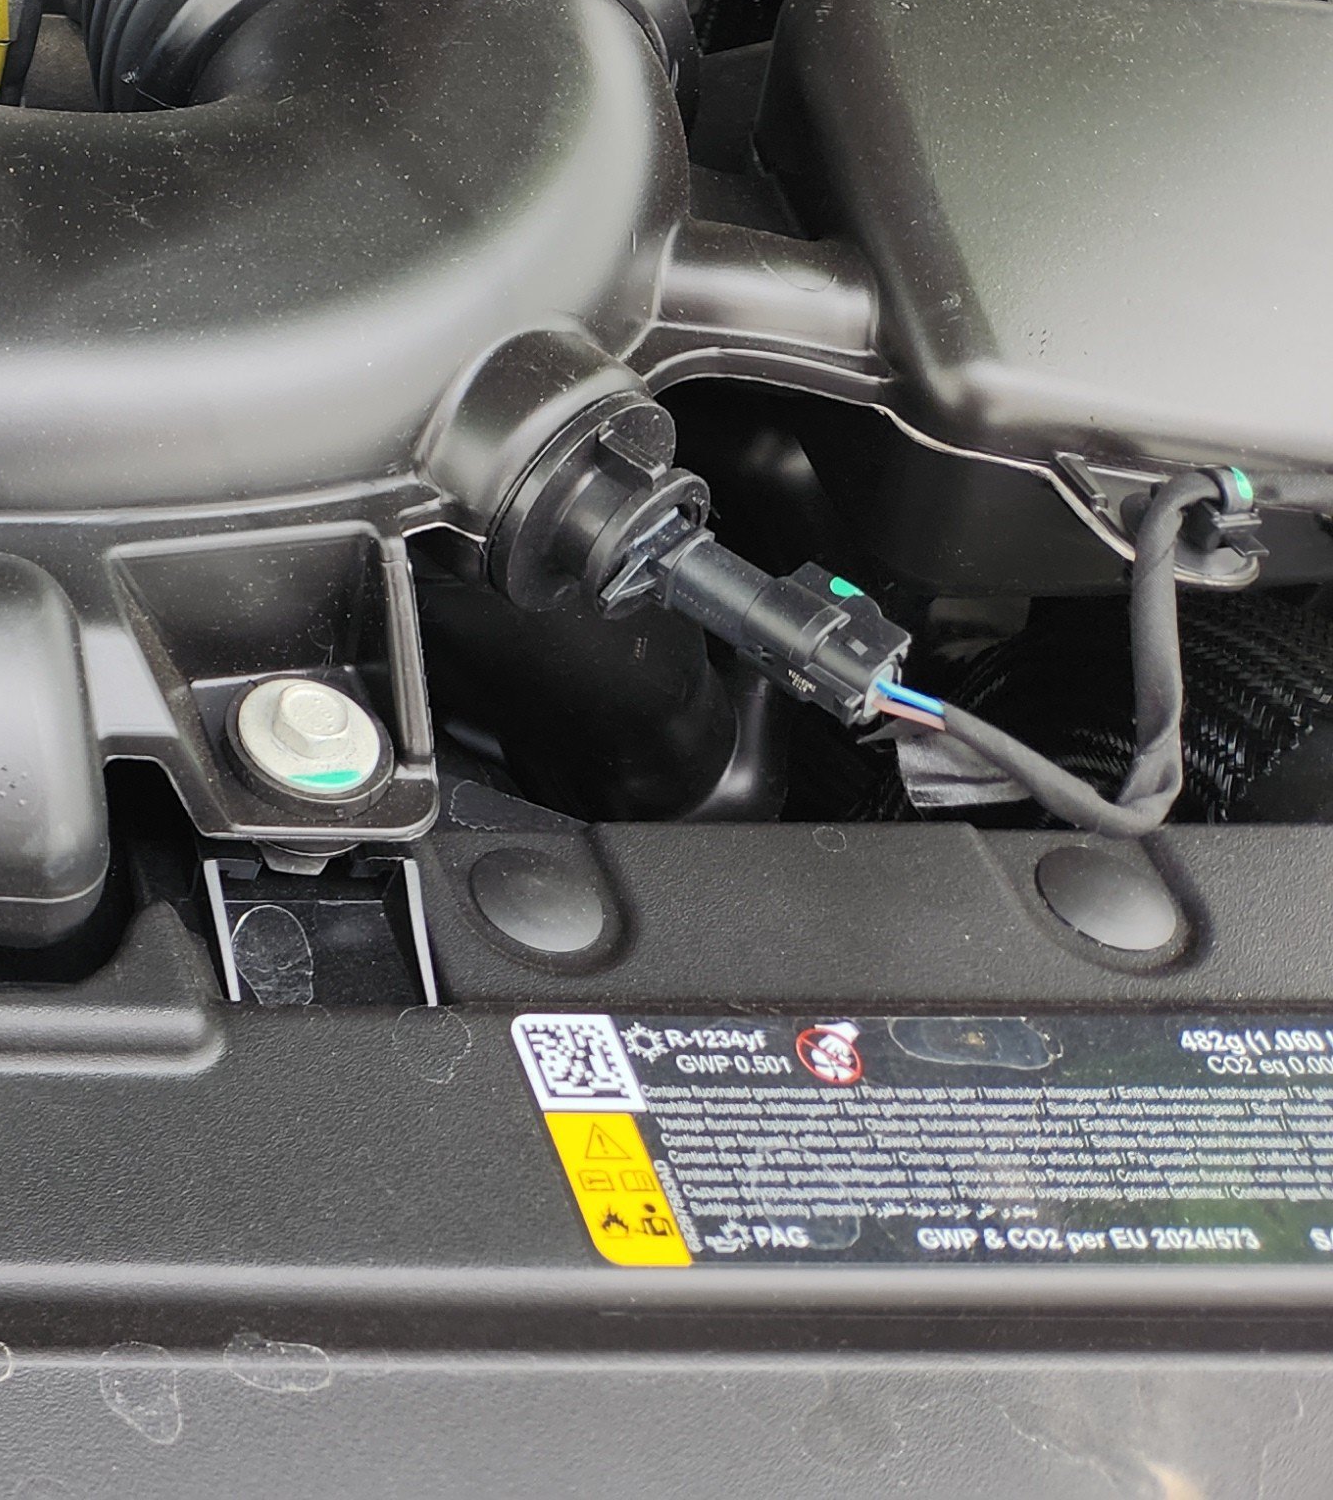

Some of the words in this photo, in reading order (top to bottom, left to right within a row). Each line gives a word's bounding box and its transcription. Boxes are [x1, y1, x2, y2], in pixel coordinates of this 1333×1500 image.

[664, 1029, 767, 1053] R-1234yf
[1181, 1029, 1247, 1055] 482g
[676, 1054, 732, 1074] GWP
[733, 1055, 792, 1074] 0.501
[1207, 1055, 1258, 1074] CO2
[1259, 1058, 1290, 1077] eq
[752, 1086, 819, 1102] greenhouse
[753, 1226, 808, 1248] PAG
[917, 1227, 978, 1250] GWP
[983, 1227, 1006, 1250] &
[1008, 1227, 1064, 1250] CO2
[1065, 1232, 1107, 1253] per
[1109, 1227, 1149, 1250] EU
[1150, 1227, 1260, 1250] 2024/573
